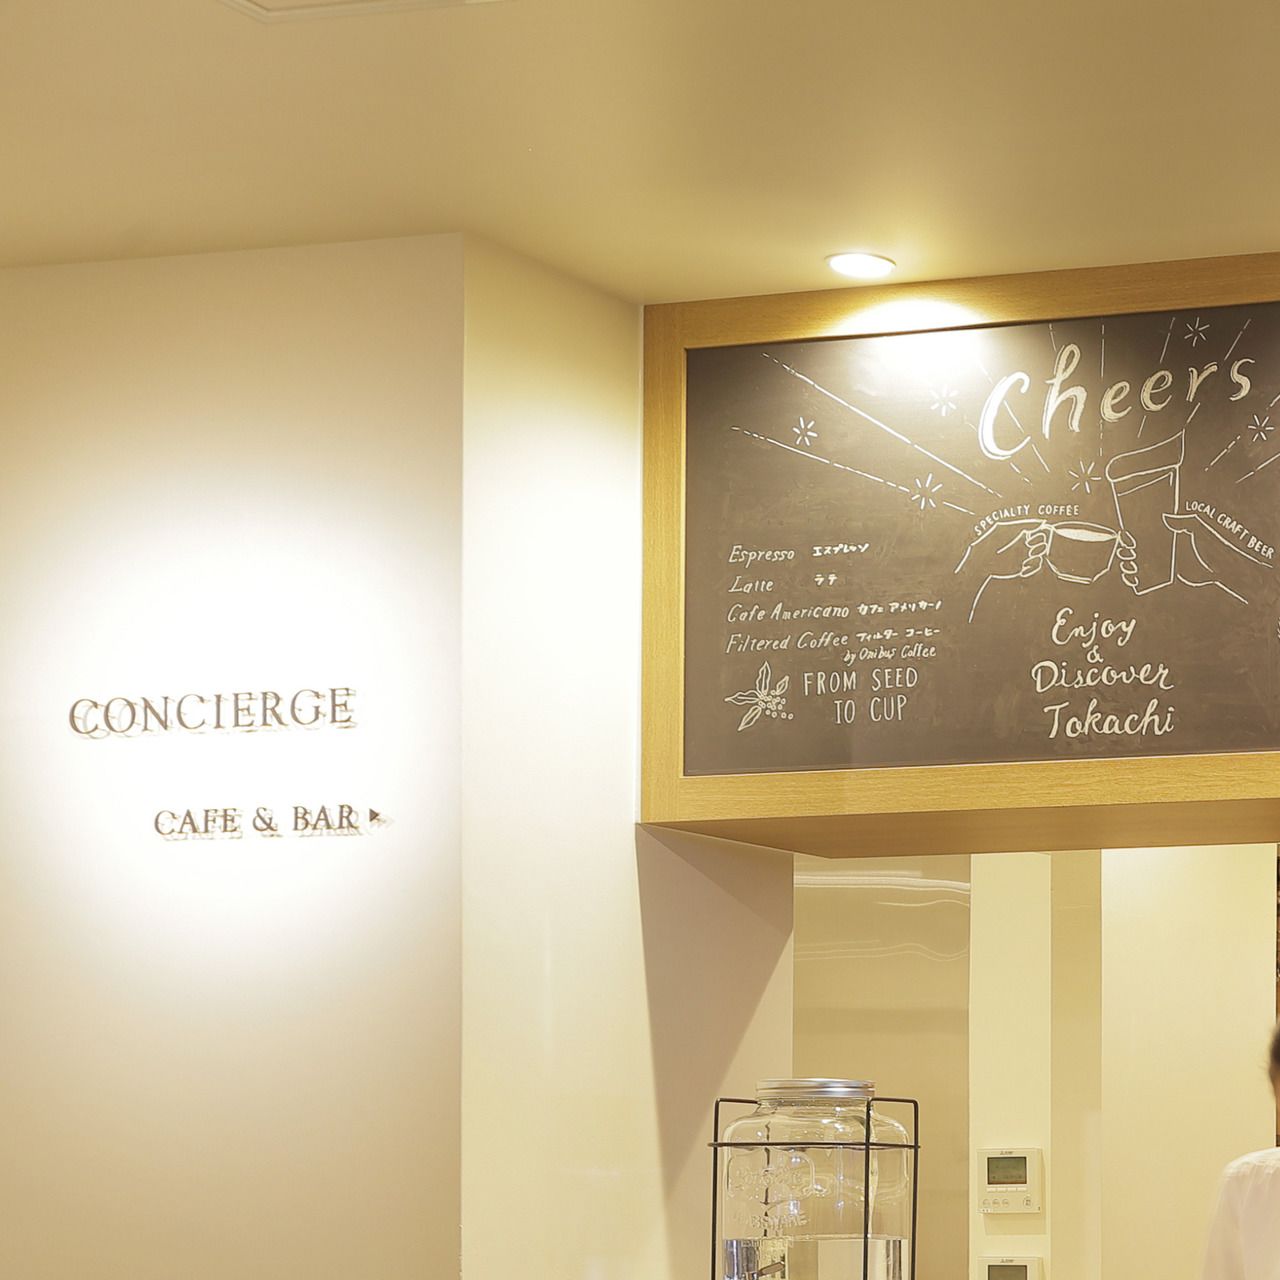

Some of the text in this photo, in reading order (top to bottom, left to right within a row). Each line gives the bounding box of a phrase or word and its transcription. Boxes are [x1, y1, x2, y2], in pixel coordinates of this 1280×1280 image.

[977, 343, 1255, 460] Cheers
[974, 504, 1080, 536] SPECIALTY COFFEE
[1185, 501, 1275, 560] LOCAL CRAFT BEER
[728, 545, 796, 569] Espresso
[728, 575, 774, 594] Latte
[814, 573, 838, 587] ラテ
[727, 602, 850, 623] Cafe Americano
[1051, 607, 1137, 648] Enjoy
[726, 631, 849, 654] Filtered Coffee
[843, 643, 937, 667] by Onibus Coffee
[1086, 644, 1104, 664] &
[803, 666, 919, 696] FROM SEED
[1032, 660, 1176, 694] Discover
[68, 686, 358, 737] CONCIERGE
[834, 694, 908, 725] TO CUP
[1043, 698, 1176, 740] Tokachi
[153, 803, 361, 838] CAFE & BAR
